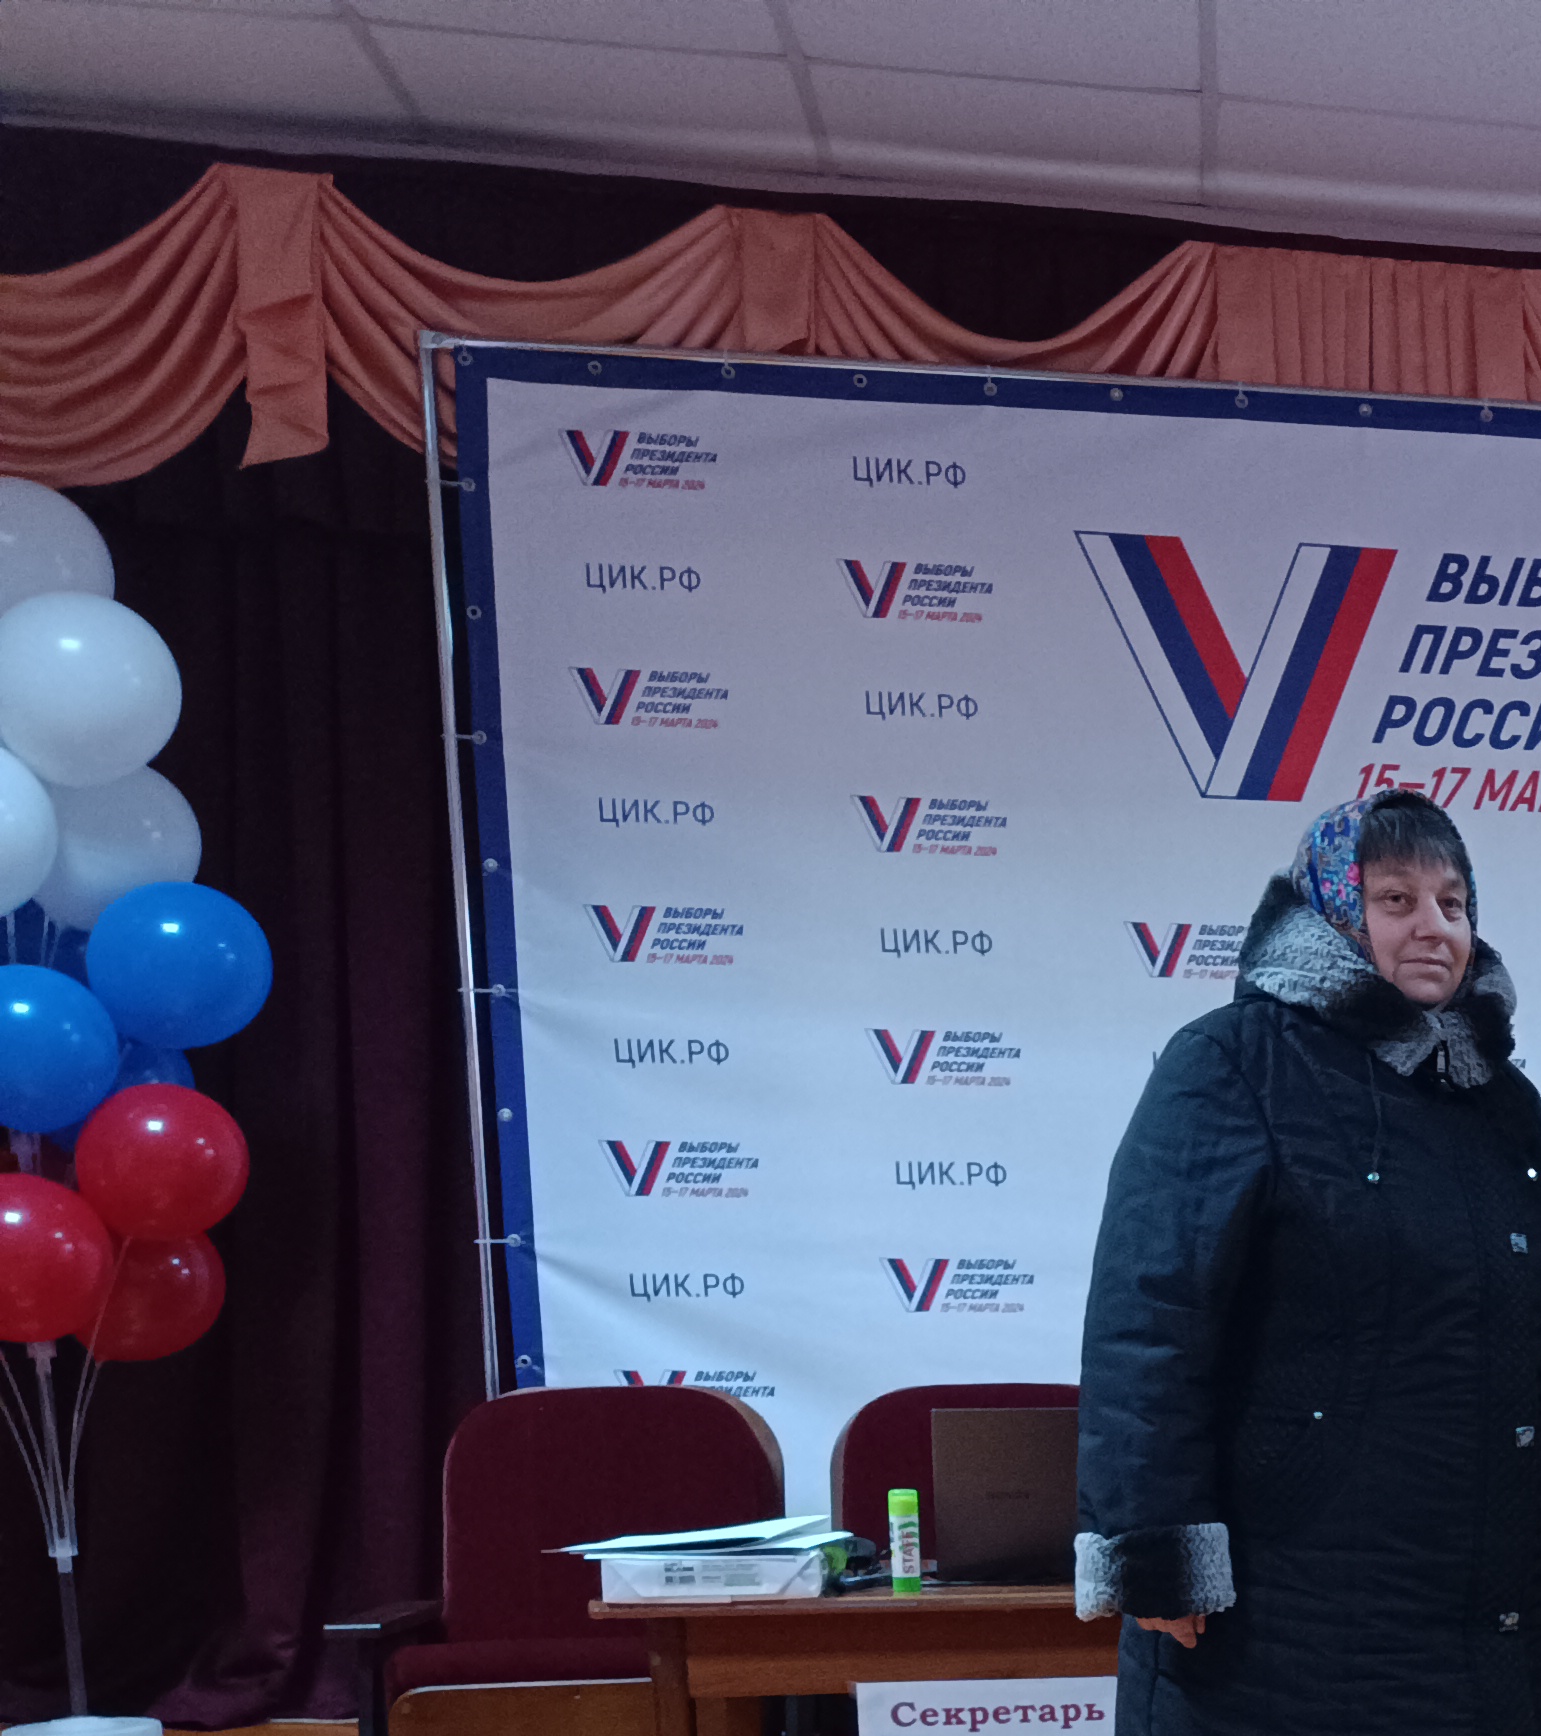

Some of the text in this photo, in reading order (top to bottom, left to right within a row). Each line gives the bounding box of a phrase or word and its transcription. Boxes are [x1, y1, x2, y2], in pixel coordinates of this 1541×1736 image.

[637, 432, 699, 447] ВЫБОРЫ
[631, 448, 717, 463] ПРЕЗИДЕНТА
[624, 464, 679, 475] РОССИИ
[853, 456, 965, 488] ЦИК.РФ
[914, 563, 974, 577] ВЫБОРЫ
[586, 563, 700, 593] ЦИК.РФ
[908, 579, 993, 594] ПРЕЗИДЕНТА
[902, 595, 957, 607] РОССИИ
[648, 671, 710, 683] ВЫБОРЫ
[642, 686, 728, 700] ПРЕЗИДЕНТА
[636, 702, 691, 714] РОССИИ
[866, 691, 978, 720] ЦИК.РФ
[929, 799, 988, 811] ВЫБОРЫ
[599, 798, 714, 827] ЦИК.РФ
[923, 814, 1007, 828] ПРЕЗИДЕНТА
[917, 829, 970, 841] РОССИИ
[663, 907, 724, 919] ВЫБОРЫ
[658, 922, 743, 936] ПРЕЗИДЕНТА
[1198, 924, 1245, 936] ВЫБОР
[651, 938, 706, 950] РОССИИ
[881, 929, 992, 958] ЦИК.РФ
[943, 1031, 1003, 1043] ВЫБОРЫ
[614, 1038, 729, 1068] ЦИК.РФ
[937, 1046, 1021, 1059] ПРЕЗИДЕНТА
[931, 1061, 985, 1072] РОССИИ
[678, 1142, 740, 1153] ВЫБОРЫ
[672, 1157, 759, 1170] ПРЕЗИДЕНТА
[666, 1172, 722, 1184] РОССИИ
[896, 1161, 1006, 1189] ЦИК.РФ
[957, 1259, 1016, 1270] ВЫБОРЫ
[951, 1274, 1034, 1286] ПРЕЗИДЕНТА
[630, 1273, 744, 1302] ЦИК.РФ
[945, 1289, 999, 1299] РОССИИ
[694, 1370, 757, 1382] ВЫБОРЫ
[891, 1702, 1105, 1732] Секретарь
